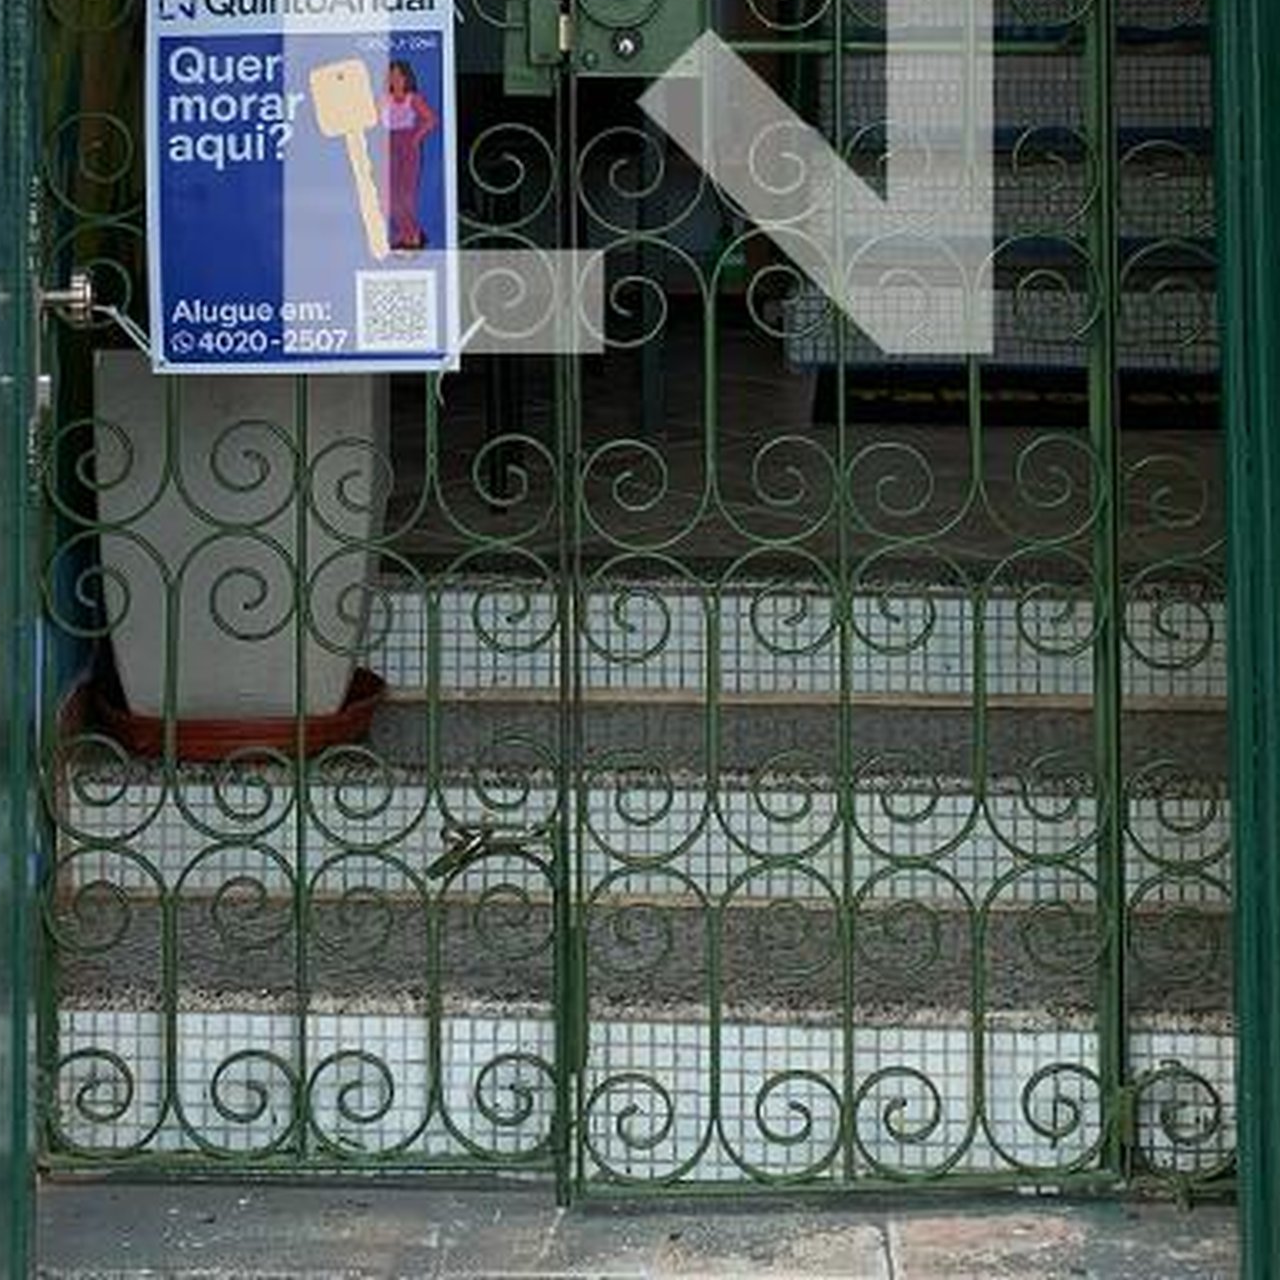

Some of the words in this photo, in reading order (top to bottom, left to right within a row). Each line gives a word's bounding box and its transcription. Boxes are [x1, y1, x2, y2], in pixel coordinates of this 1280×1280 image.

[168, 46, 282, 84] Quer
[168, 93, 305, 123] morar
[169, 124, 294, 170] aqui?
[171, 299, 272, 326] Alugue
[280, 301, 332, 321] em:
[198, 329, 348, 354] 4020-2507
